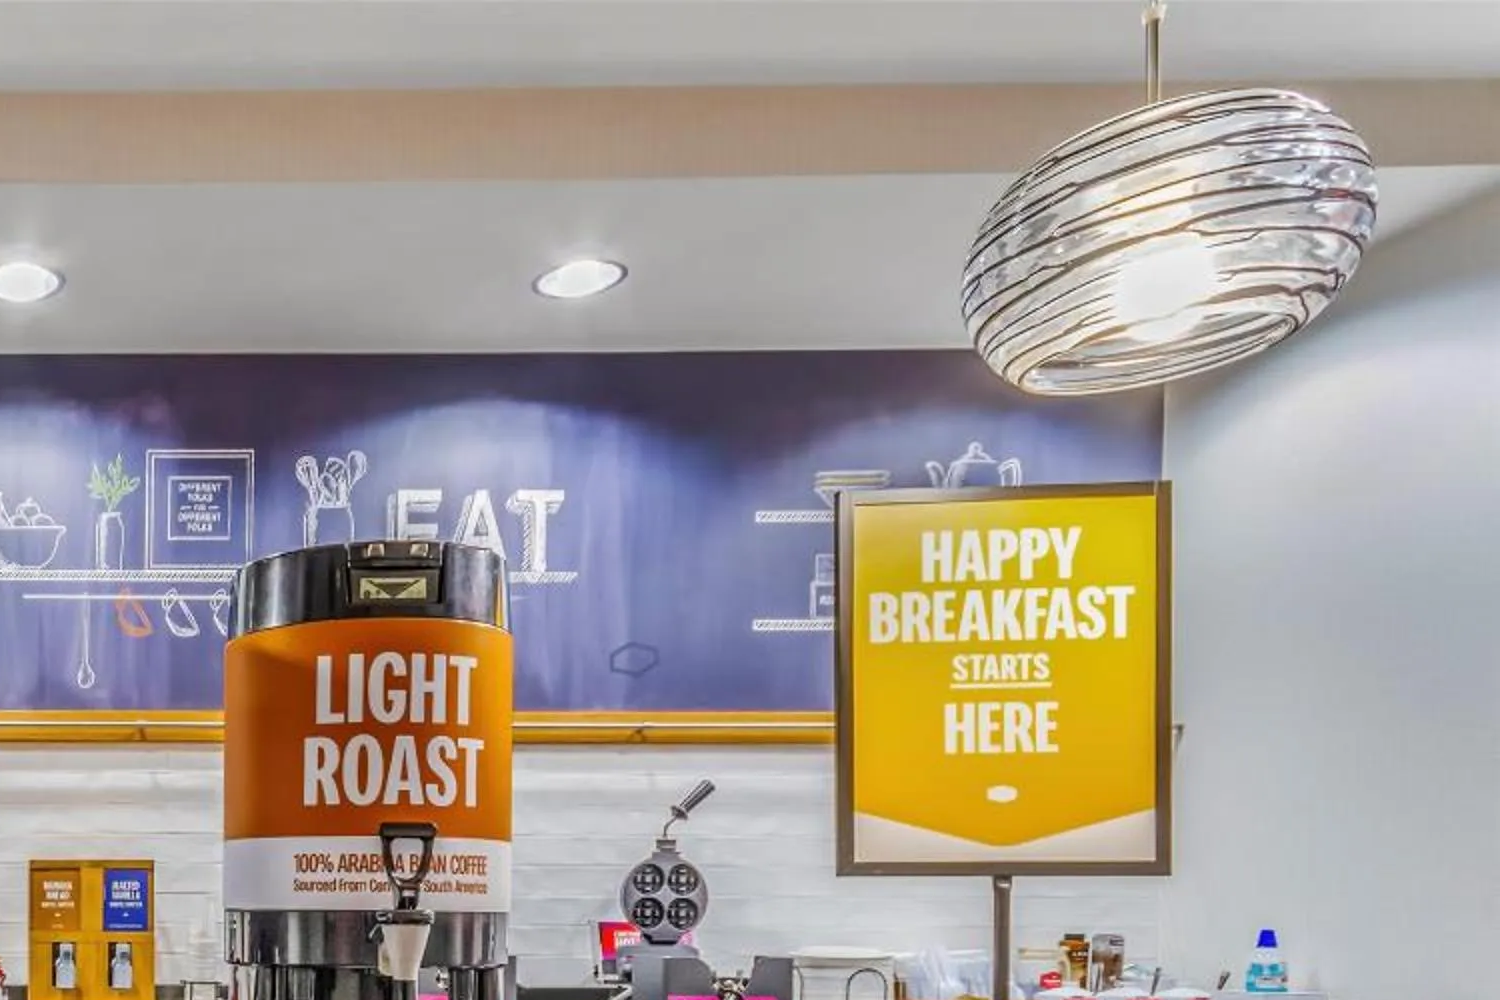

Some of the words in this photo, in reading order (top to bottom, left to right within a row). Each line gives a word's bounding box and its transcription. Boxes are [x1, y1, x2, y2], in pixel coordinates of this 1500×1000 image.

[387, 488, 565, 573] EAT
[920, 526, 1083, 583] HAPPY
[868, 585, 1136, 644] BREAKFAST
[315, 651, 479, 726] LIGHT
[951, 652, 1051, 682] STARTS
[943, 701, 1060, 754] HERE
[303, 733, 485, 808] ROAST
[293, 853, 335, 873] 100%
[337, 853, 405, 873] ARABIA
[409, 853, 447, 873] BAN
[450, 855, 488, 875] COFFEE
[293, 878, 337, 893] Sourced
[339, 878, 366, 893] From
